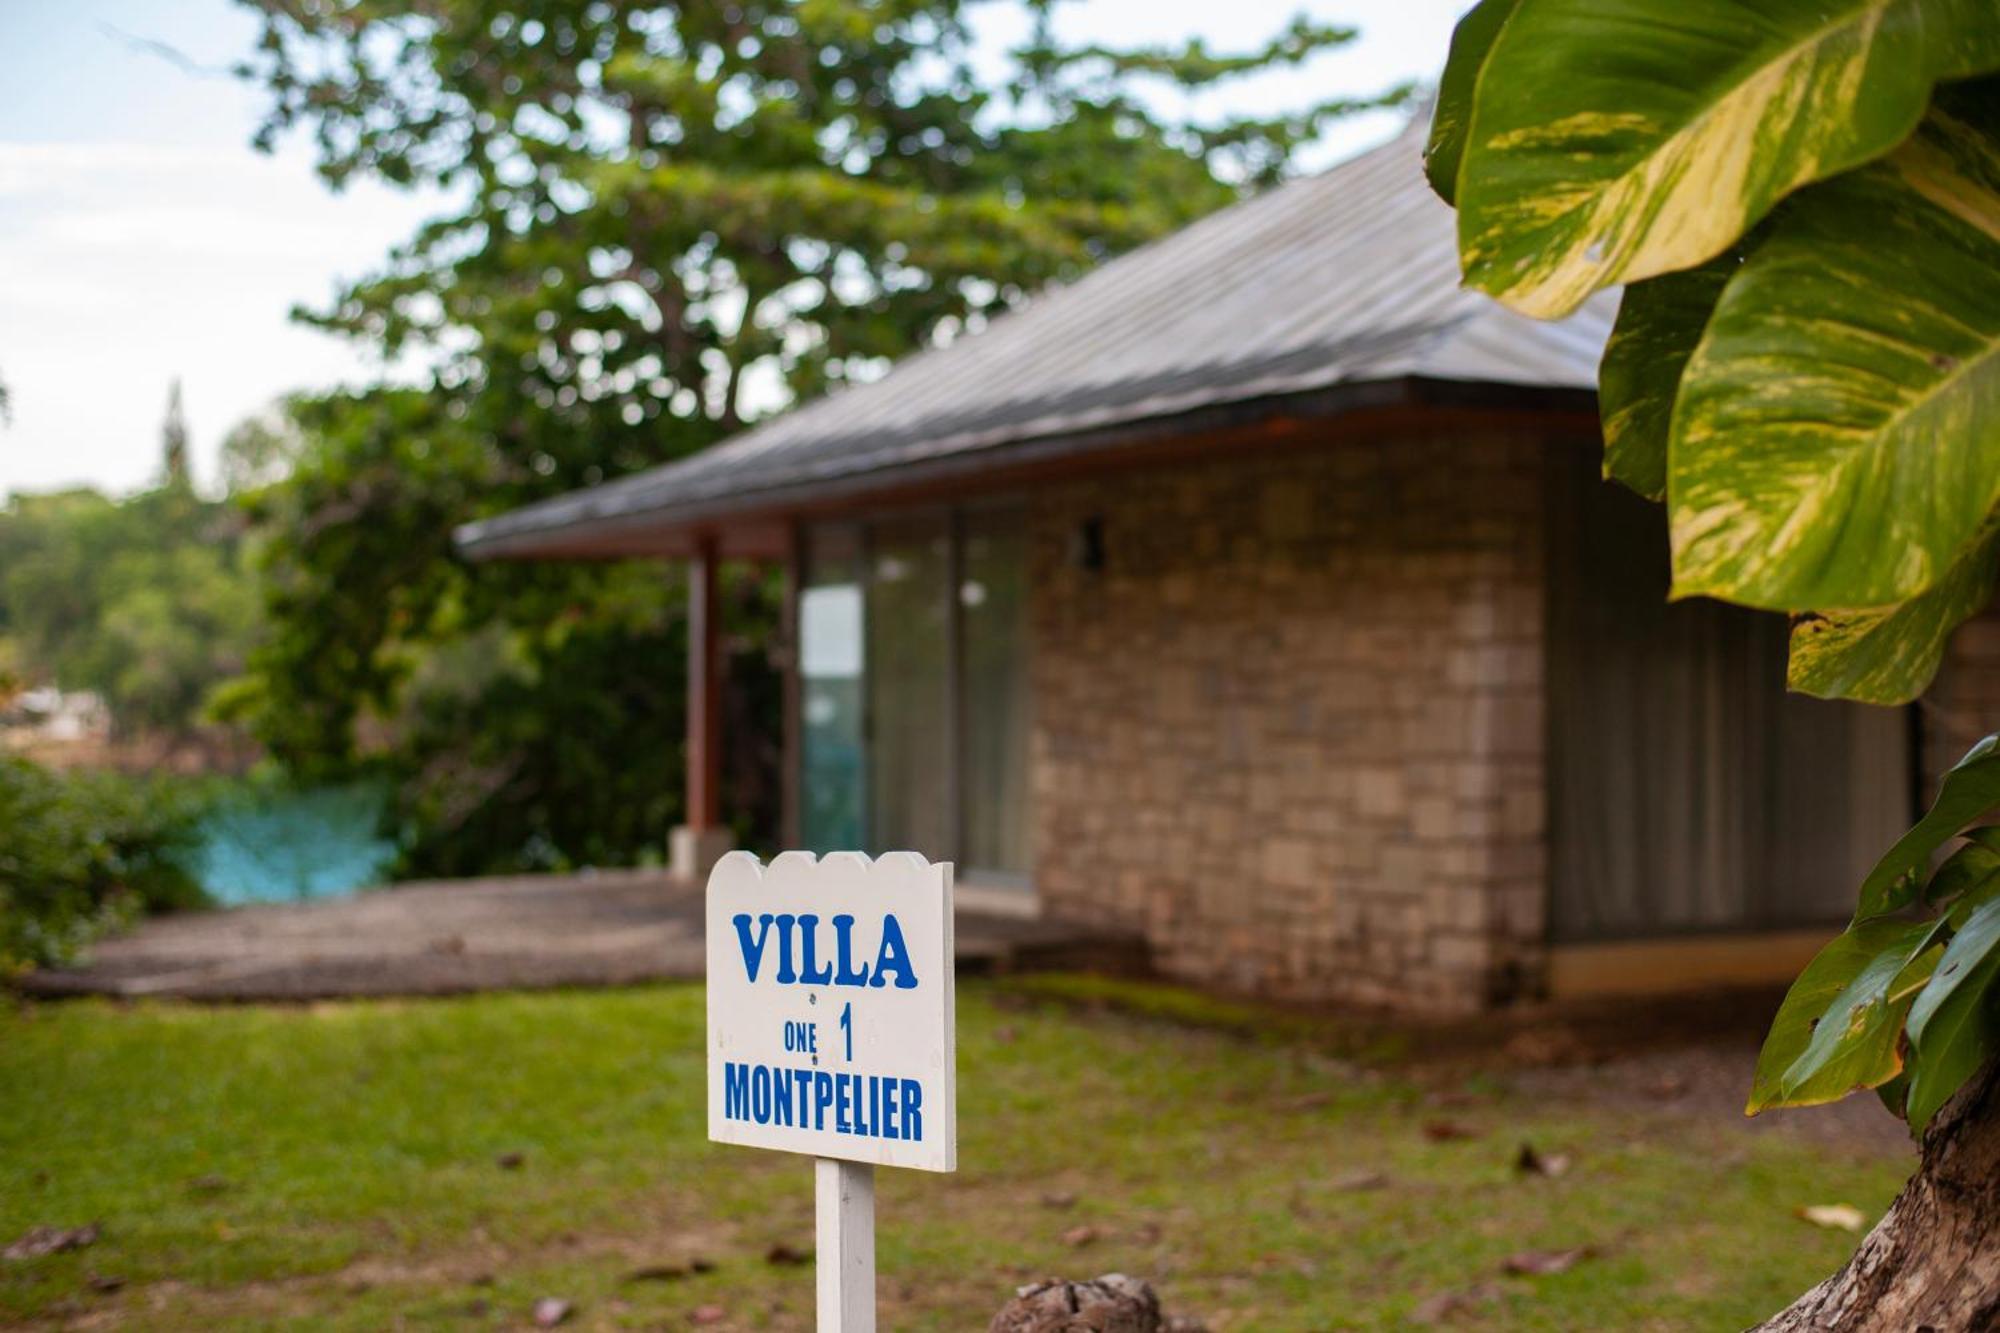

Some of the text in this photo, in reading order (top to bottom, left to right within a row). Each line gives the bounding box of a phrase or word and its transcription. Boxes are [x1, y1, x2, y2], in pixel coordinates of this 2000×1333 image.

[732, 913, 918, 989] VILLA
[784, 1002, 852, 1062] ONE 1
[724, 1062, 923, 1142] MONTPELIER
